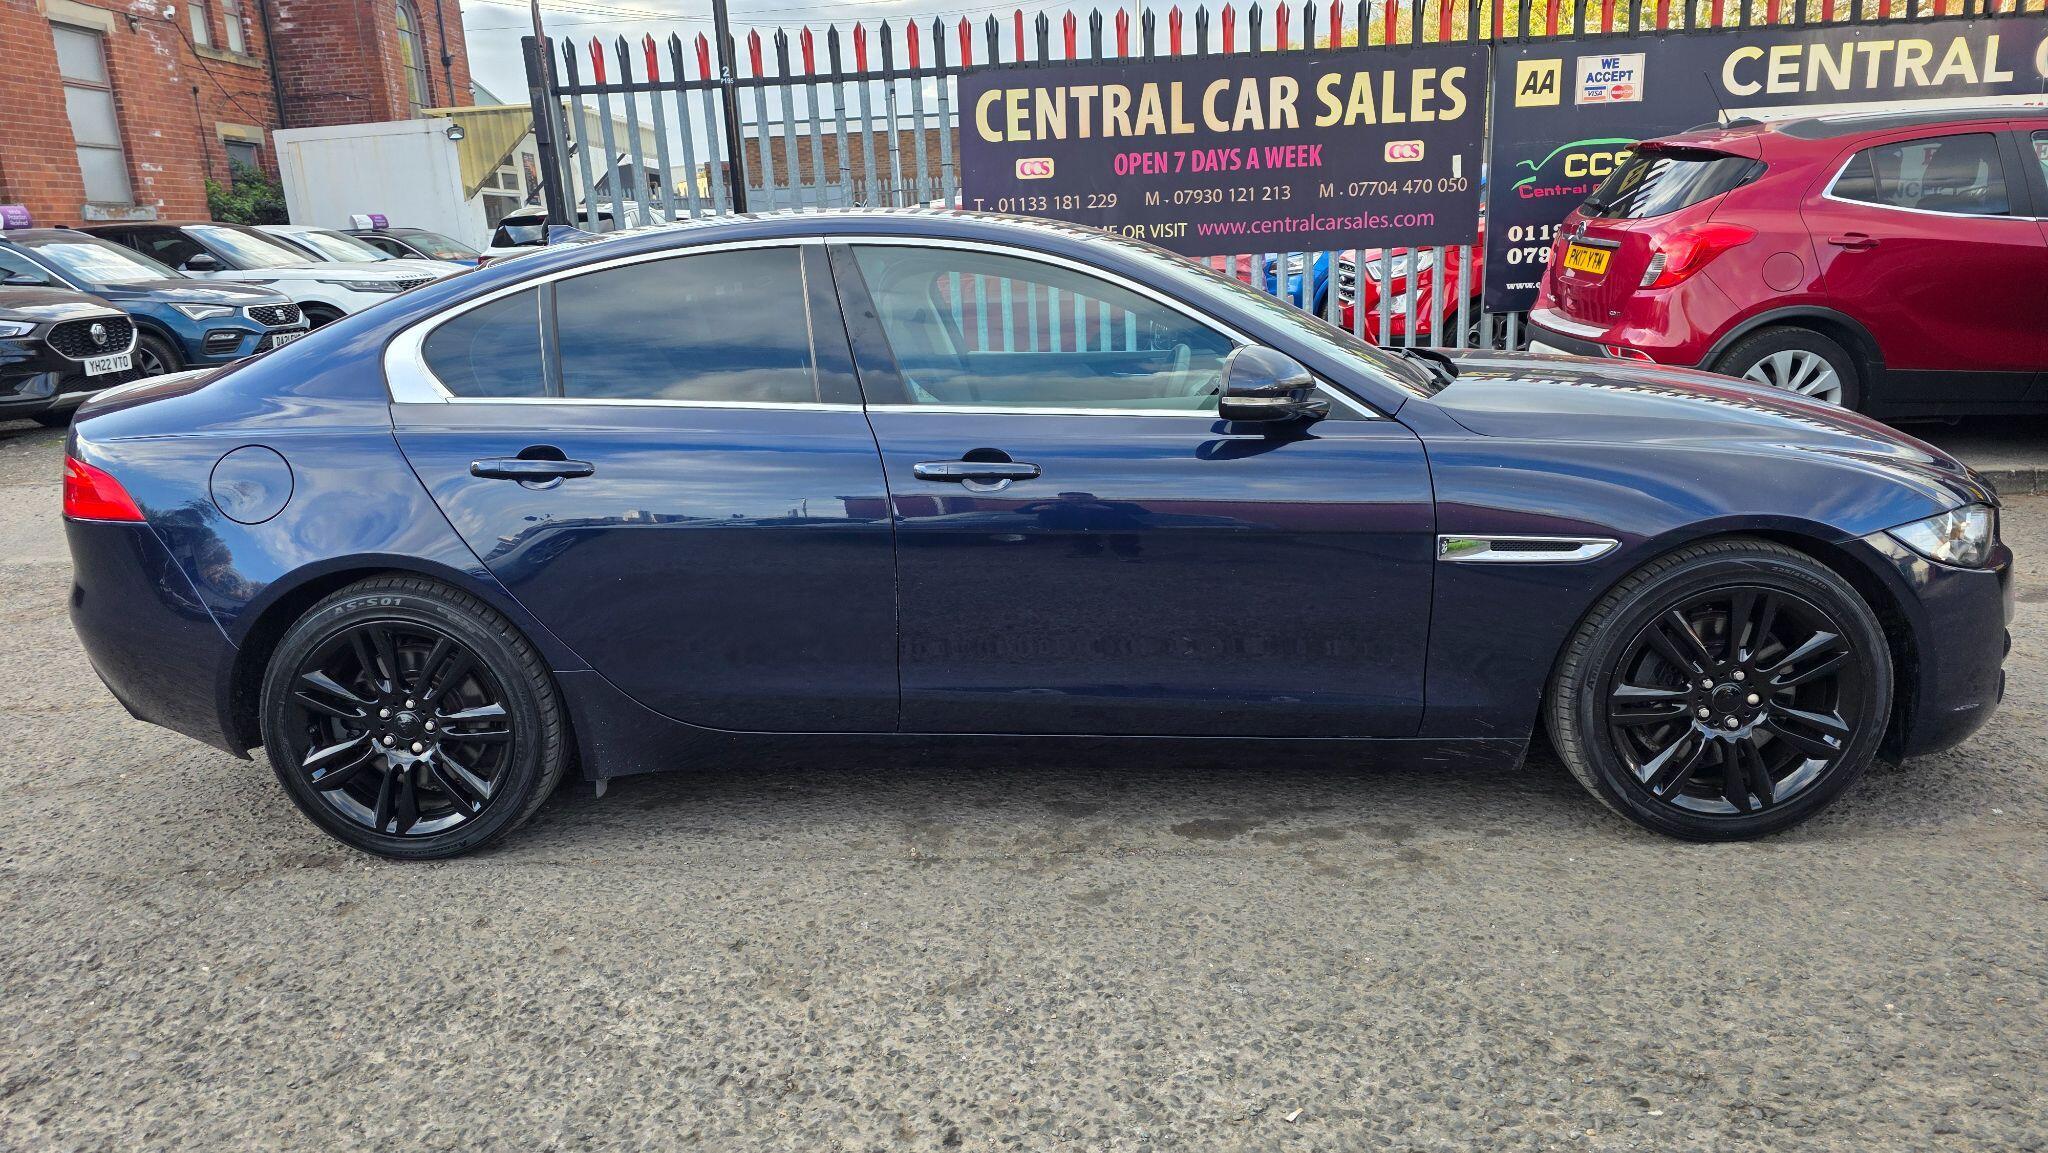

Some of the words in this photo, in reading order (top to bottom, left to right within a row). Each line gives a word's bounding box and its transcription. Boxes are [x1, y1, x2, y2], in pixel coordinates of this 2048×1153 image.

[722, 66, 730, 77] 2
[1601, 58, 1620, 70] WE
[1722, 34, 2014, 96] CENTRAL
[1521, 69, 1555, 95] AA
[1585, 70, 1634, 83] ACCEPT
[975, 81, 1195, 143] CENTRAL
[1202, 76, 1300, 133] CAR
[1315, 66, 1467, 127] SALES
[1114, 152, 1168, 176] OPEN
[1173, 151, 1185, 173] 7
[1191, 148, 1241, 173] DAYS
[1246, 146, 1260, 170] A
[1265, 144, 1323, 169] WEEK
[1389, 143, 1420, 159] CCS
[1020, 160, 1051, 177] CCS
[1174, 188, 1223, 204] 07930
[1229, 187, 1254, 202] 121
[1262, 185, 1291, 201] 213
[1348, 180, 1398, 197] 07704
[1402, 179, 1433, 194] 470
[1437, 177, 1468, 193] 050
[1518, 183, 1588, 199] Central
[998, 196, 1047, 212] 01133
[1053, 195, 1081, 210] 181
[1087, 193, 1118, 209] 229
[1122, 225, 1146, 239] OR
[1149, 222, 1188, 238] VISIT
[1197, 211, 1435, 237] www.centralcarsales.com
[89, 358, 112, 373] YH22
[112, 355, 129, 369] VTO
